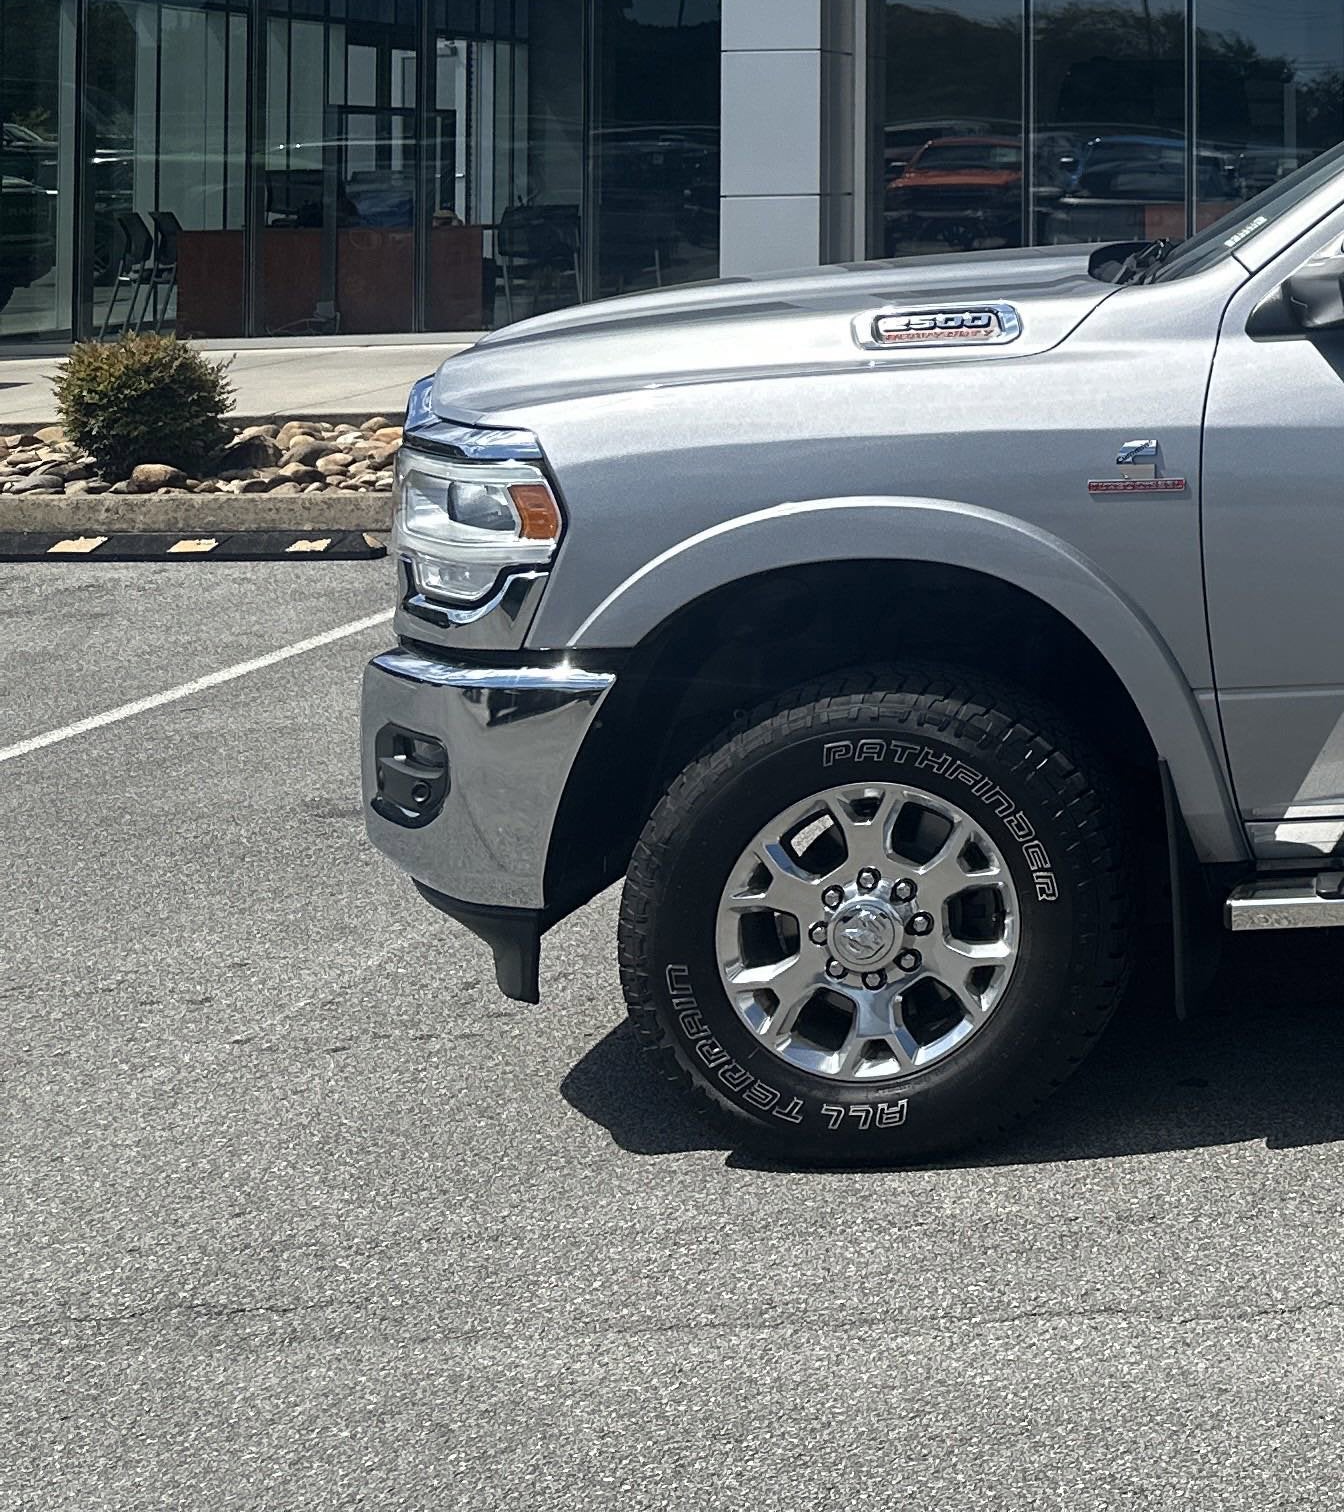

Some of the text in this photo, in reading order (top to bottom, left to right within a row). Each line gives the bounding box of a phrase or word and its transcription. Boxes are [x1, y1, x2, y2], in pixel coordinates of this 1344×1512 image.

[822, 738, 1059, 902] PATHFINDER
[665, 963, 909, 1131] ALL TERRAIN
